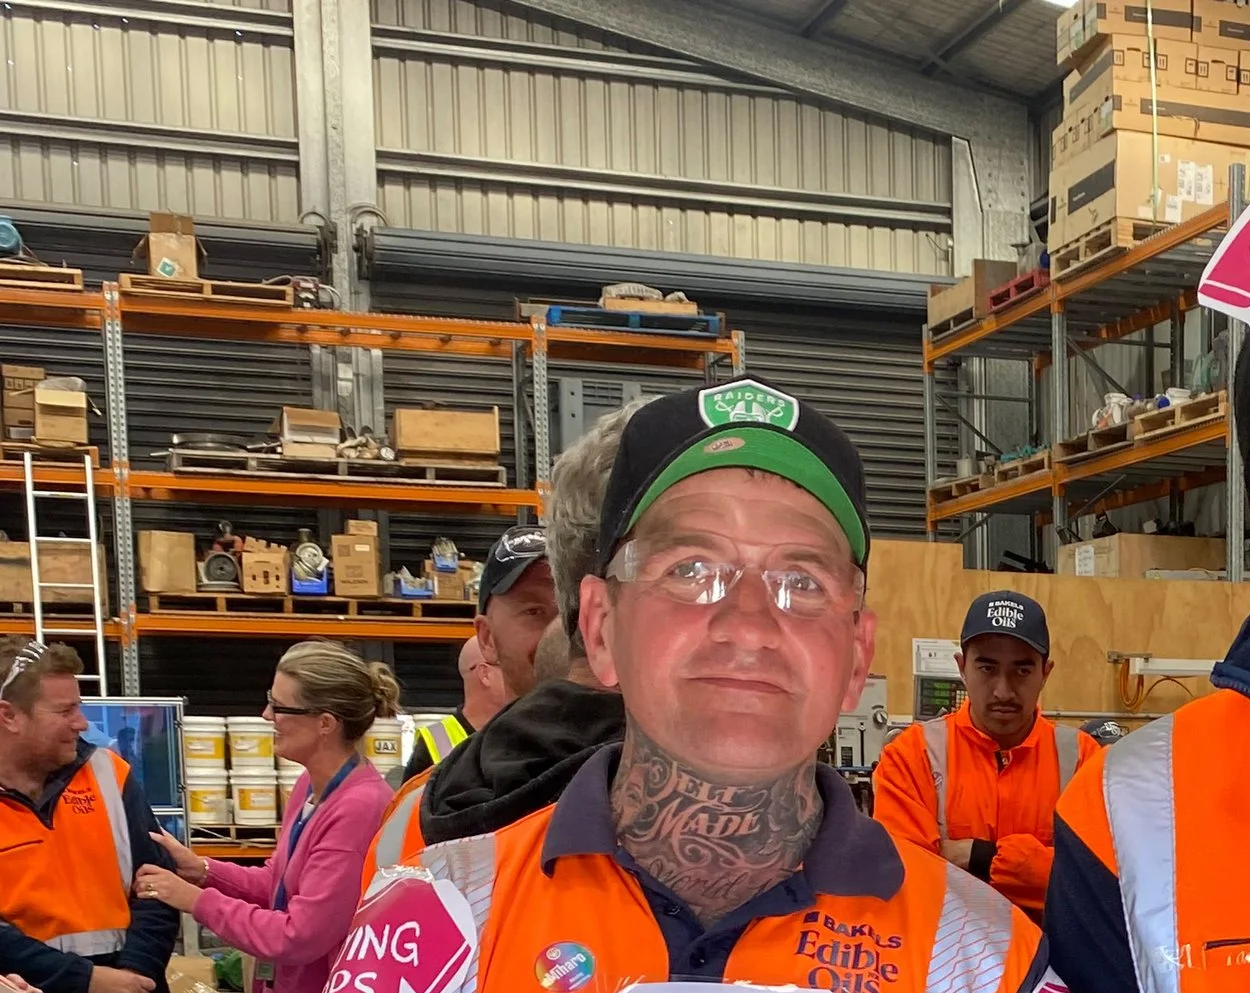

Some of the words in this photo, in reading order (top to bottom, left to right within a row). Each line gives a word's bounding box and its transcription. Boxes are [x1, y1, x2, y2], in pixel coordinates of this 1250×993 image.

[713, 391, 786, 407] RAIDERS
[987, 607, 1024, 620] Edible
[992, 617, 1016, 628] Oils
[375, 740, 397, 752] JAX
[795, 929, 899, 983] Edible
